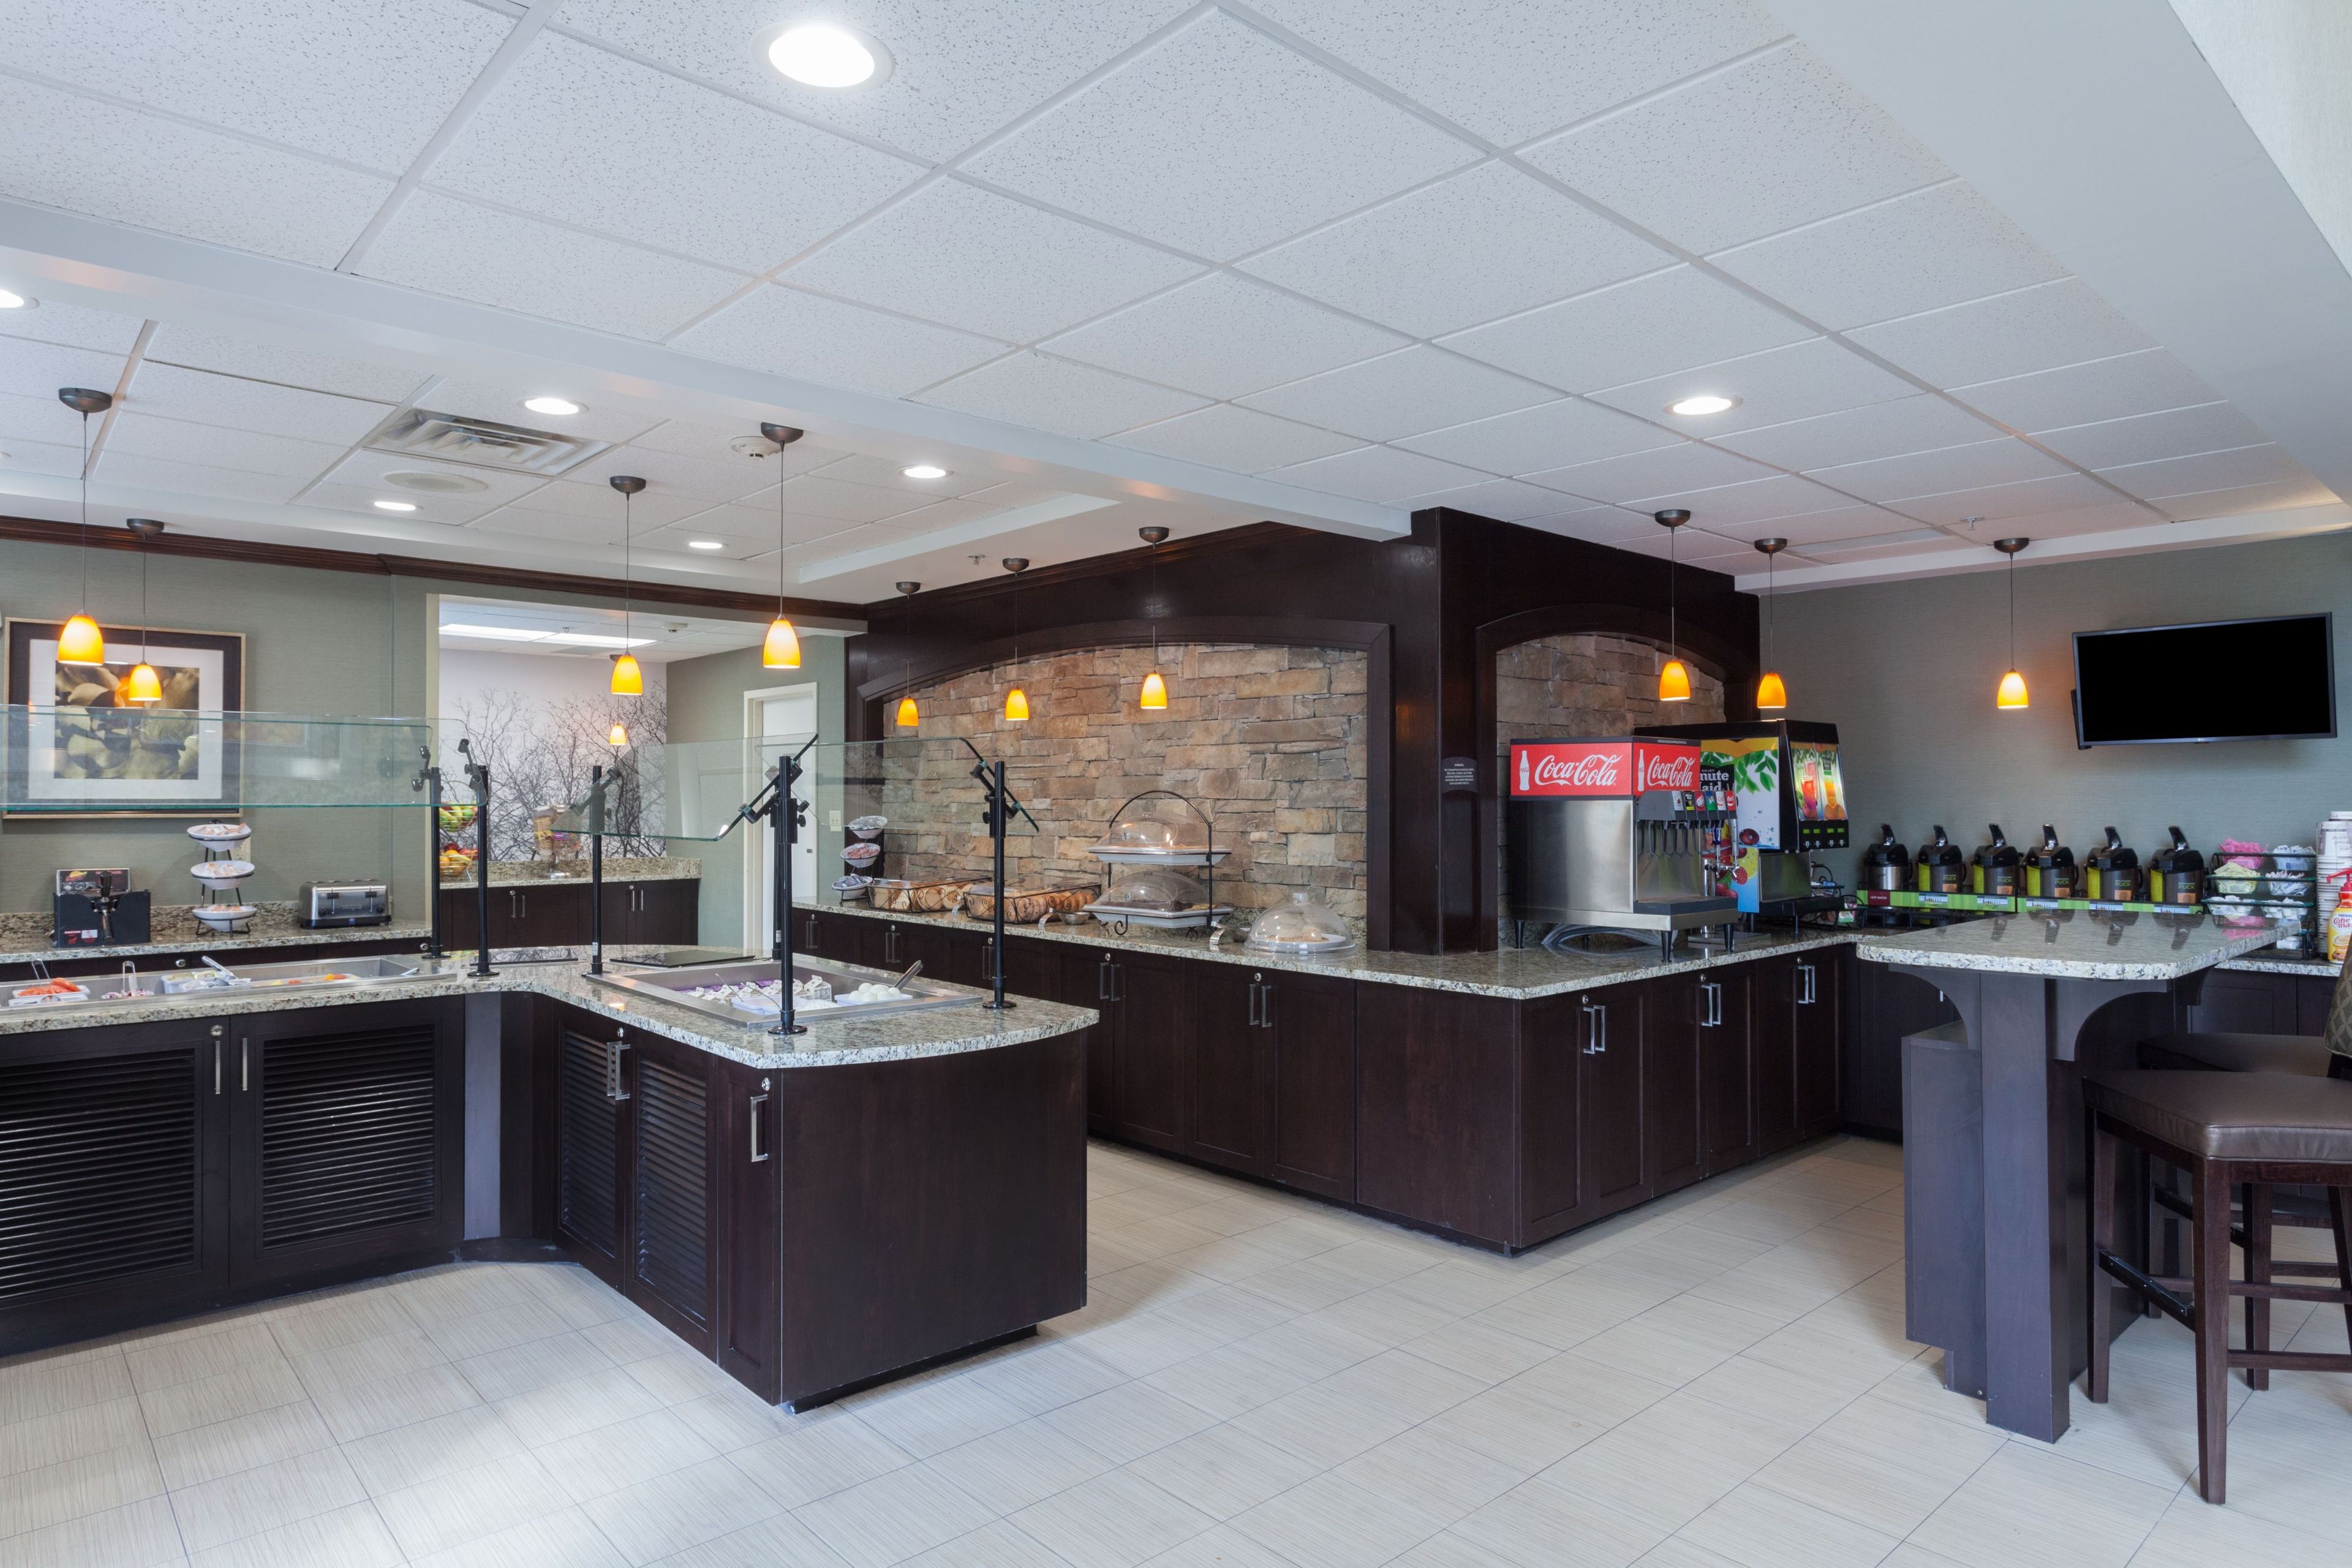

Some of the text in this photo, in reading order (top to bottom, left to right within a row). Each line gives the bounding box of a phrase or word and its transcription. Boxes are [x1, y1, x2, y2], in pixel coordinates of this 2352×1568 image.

[1534, 754, 1623, 786] Coca-Cola
[1646, 755, 1696, 787] Coca-Cola
[1700, 771, 1729, 781] nute
[1700, 782, 1722, 791] aid
